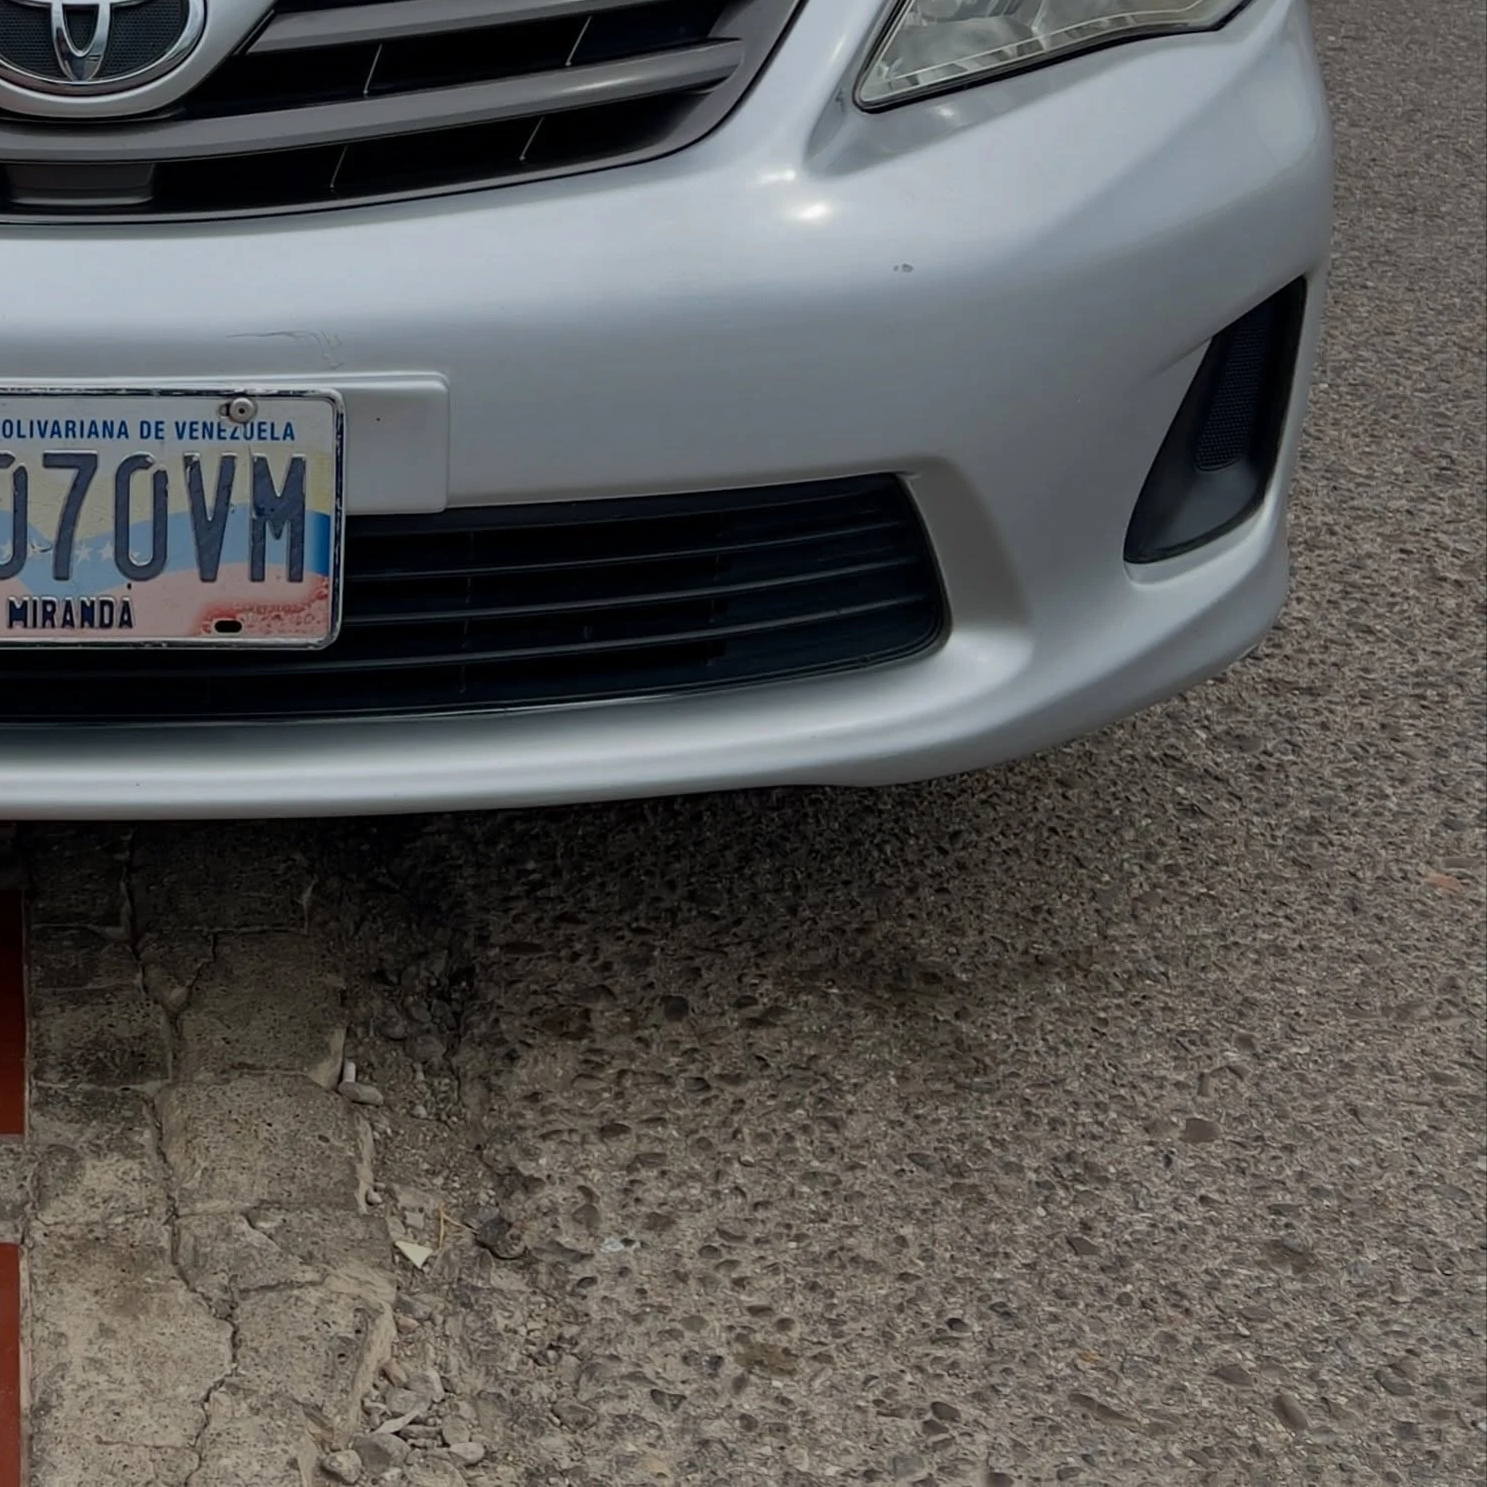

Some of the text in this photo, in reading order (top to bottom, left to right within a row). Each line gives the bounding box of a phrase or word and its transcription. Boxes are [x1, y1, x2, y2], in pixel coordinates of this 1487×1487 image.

[140, 420, 165, 440] DE
[175, 421, 296, 441] VENEZUELA
[7, 596, 134, 629] MIRANDA
